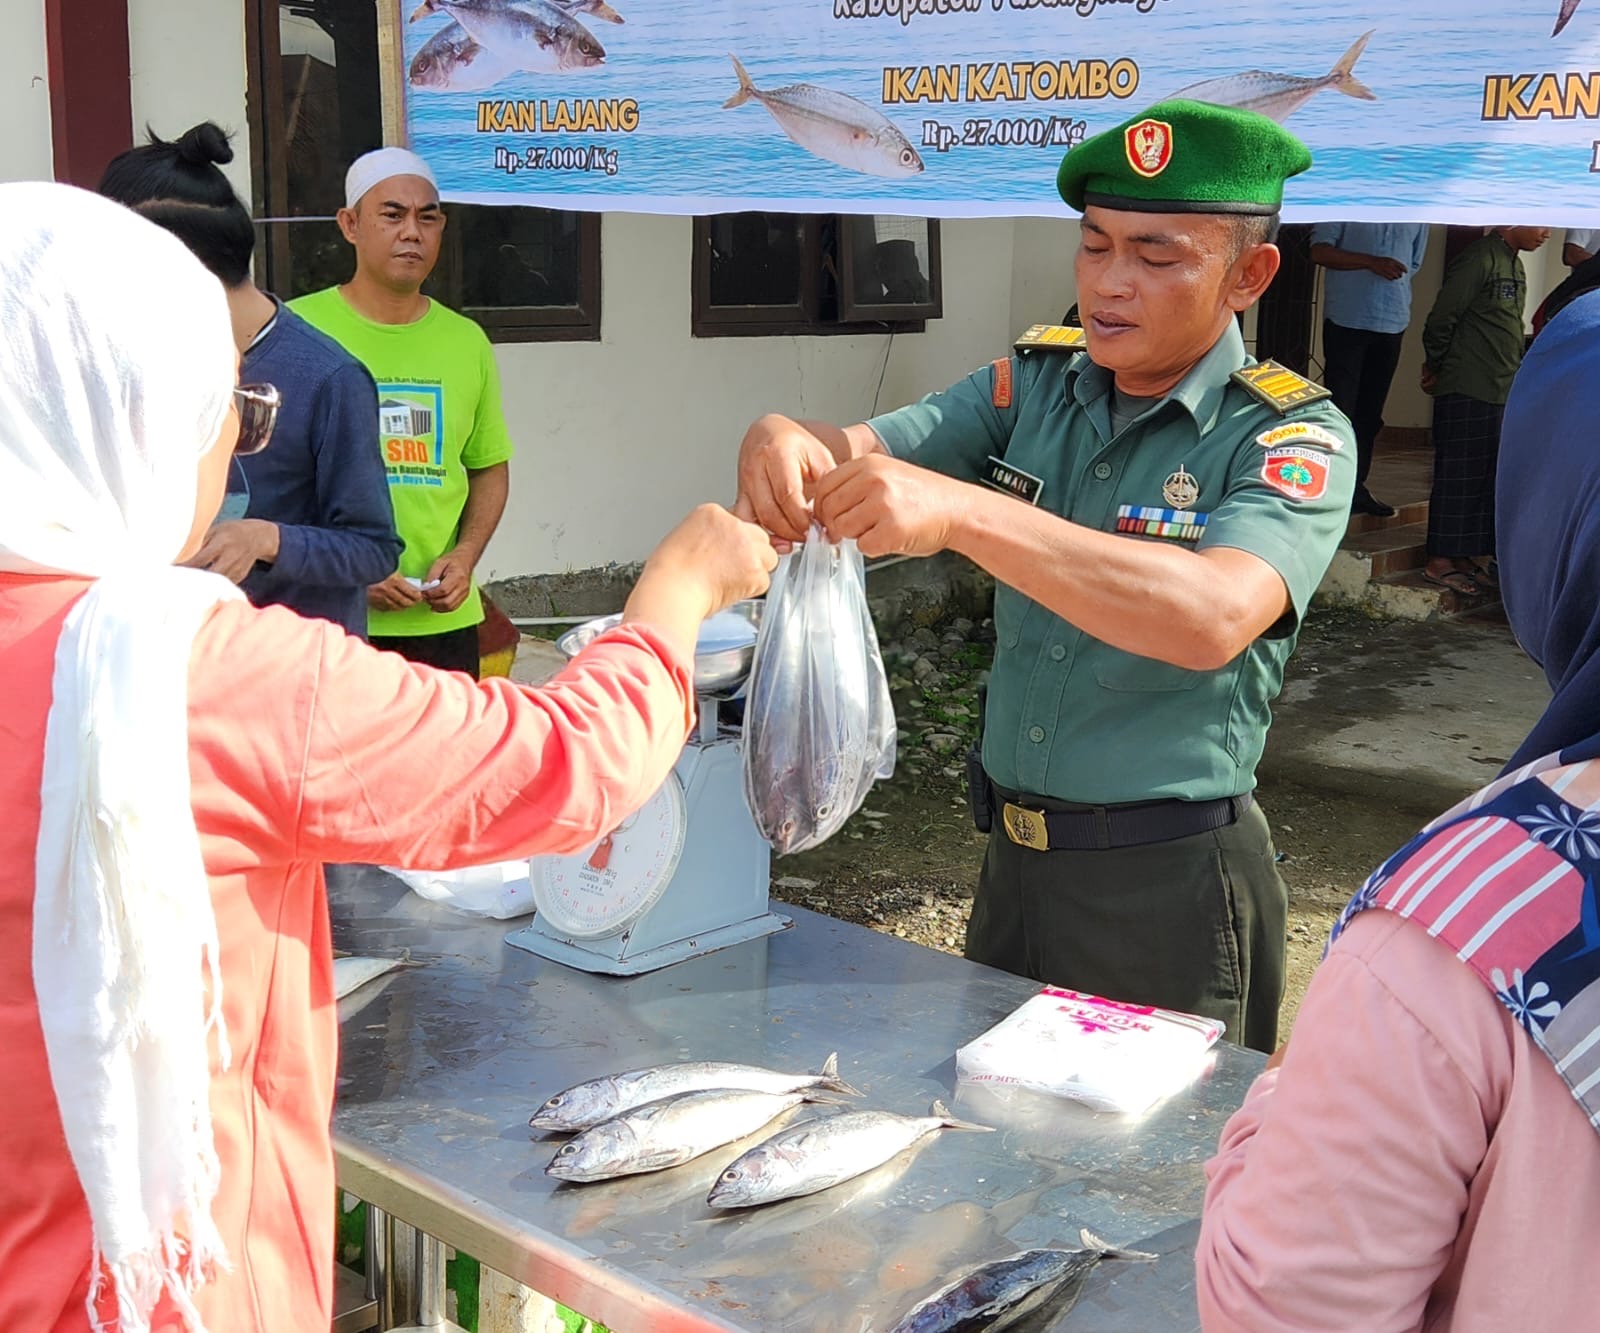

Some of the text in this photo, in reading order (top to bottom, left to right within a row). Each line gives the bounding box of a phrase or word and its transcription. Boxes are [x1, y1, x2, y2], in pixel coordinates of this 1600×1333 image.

[882, 58, 1139, 103] IKAN KATOMBO
[1480, 72, 1600, 121] IKAN
[477, 99, 639, 132] IKAN LAJANG
[922, 117, 1087, 151] Rp. 27.000/Kg
[495, 145, 619, 174] Rp. 27.000/Kg
[387, 439, 428, 463] SRD
[991, 467, 1028, 494] ISMAIL
